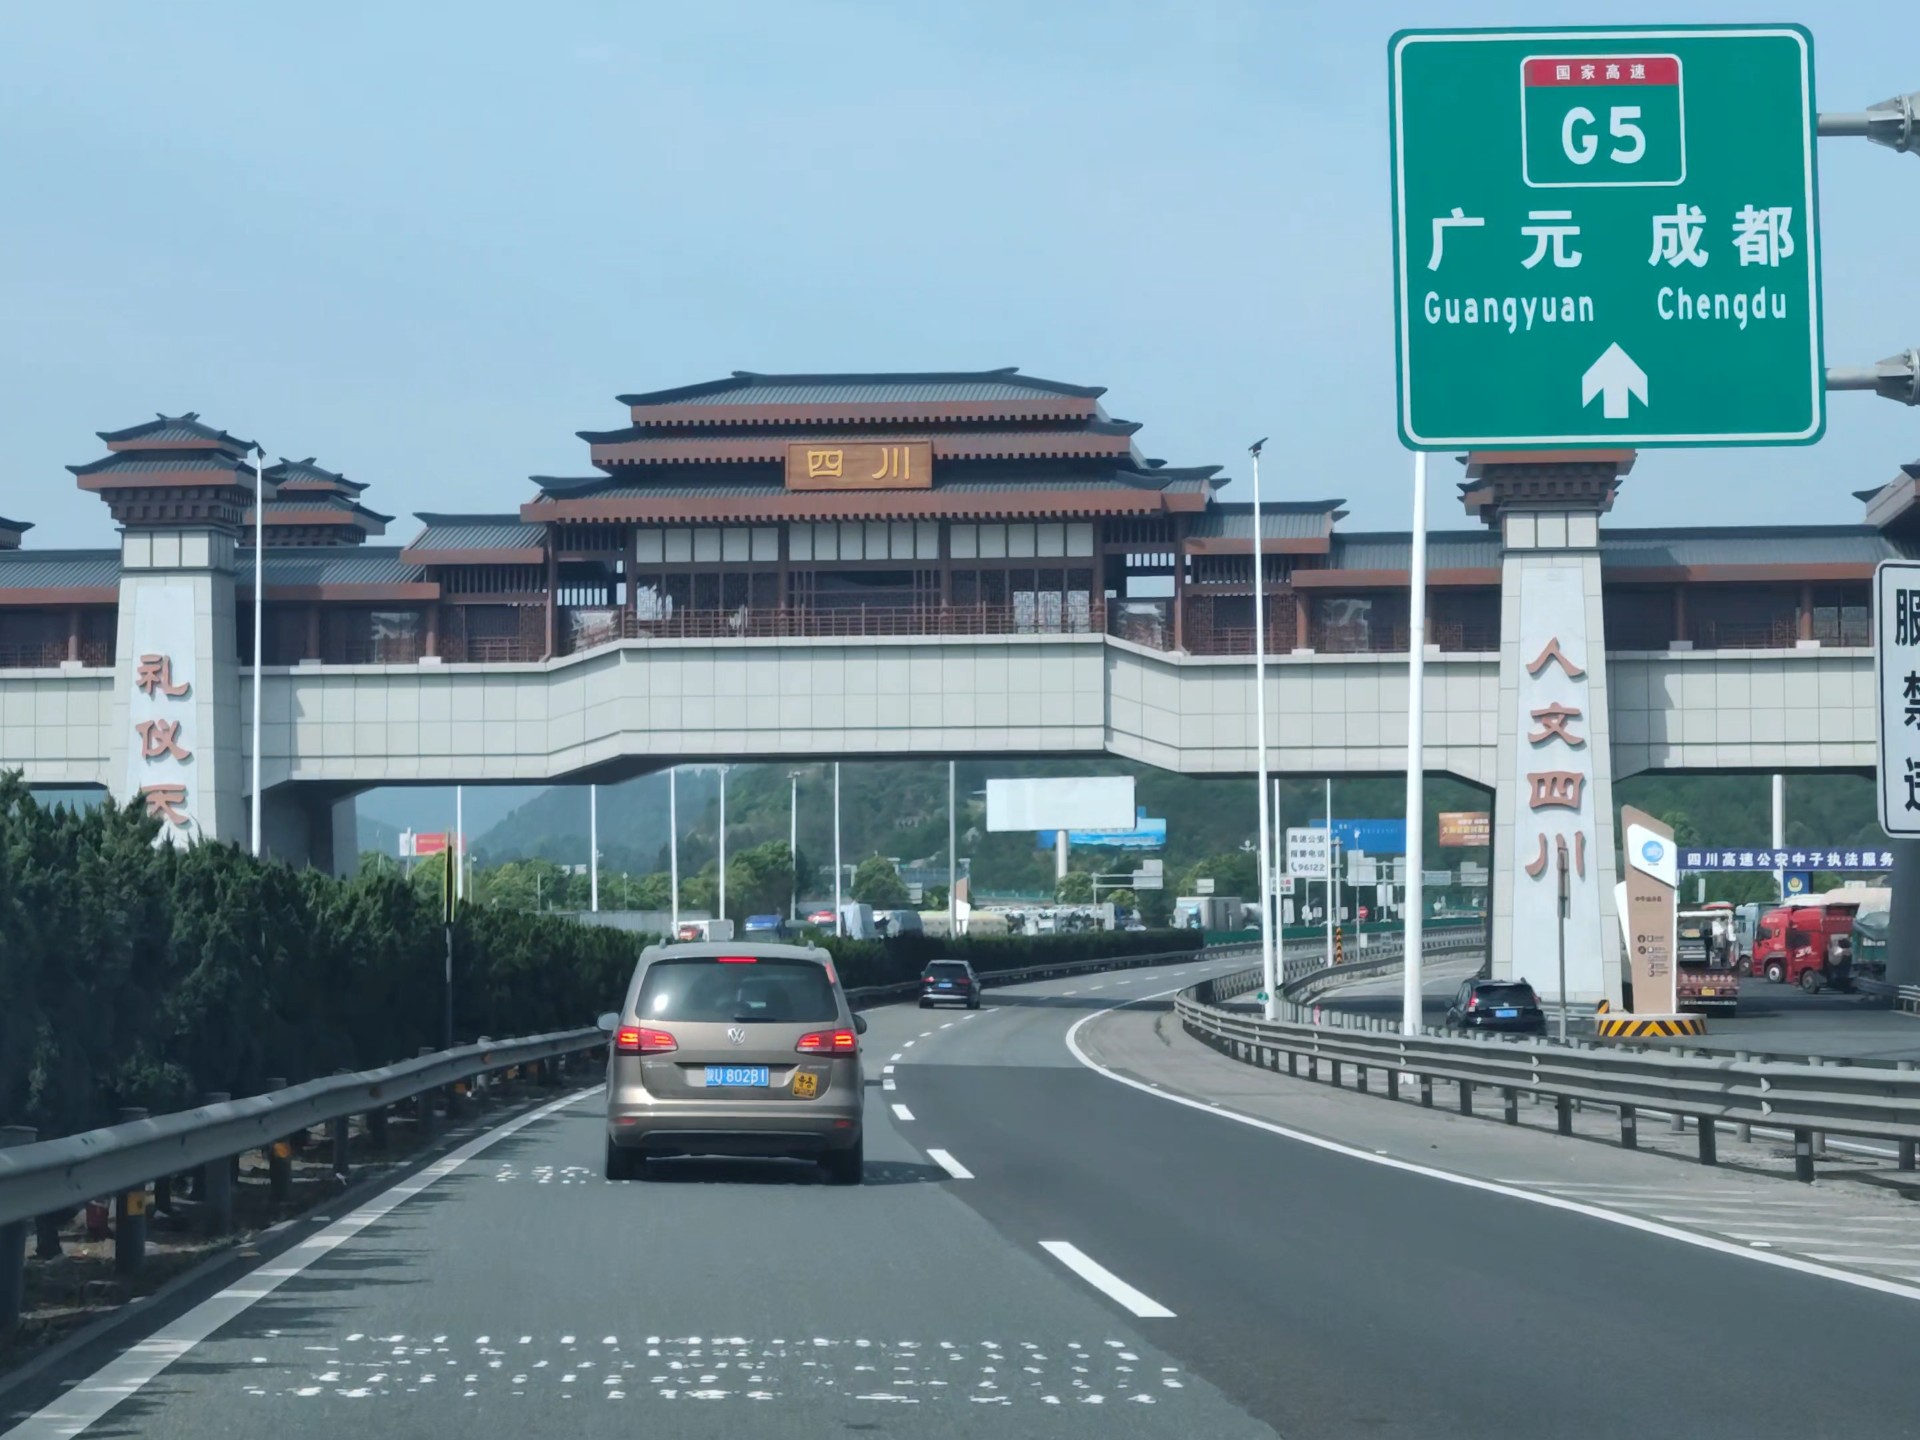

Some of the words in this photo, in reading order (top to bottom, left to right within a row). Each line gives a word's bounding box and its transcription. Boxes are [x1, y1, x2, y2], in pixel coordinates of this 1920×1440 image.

[1556, 63, 1646, 81] 国家高速
[1561, 105, 1647, 165] G5
[1426, 207, 1583, 272] 广元
[1648, 203, 1796, 269] 成都
[1424, 290, 1595, 334] Guangyuan
[1656, 286, 1788, 331] Chengdu
[807, 446, 910, 480] 四川
[1525, 636, 1586, 878] 人文四川
[1298, 863, 1326, 872] 96122
